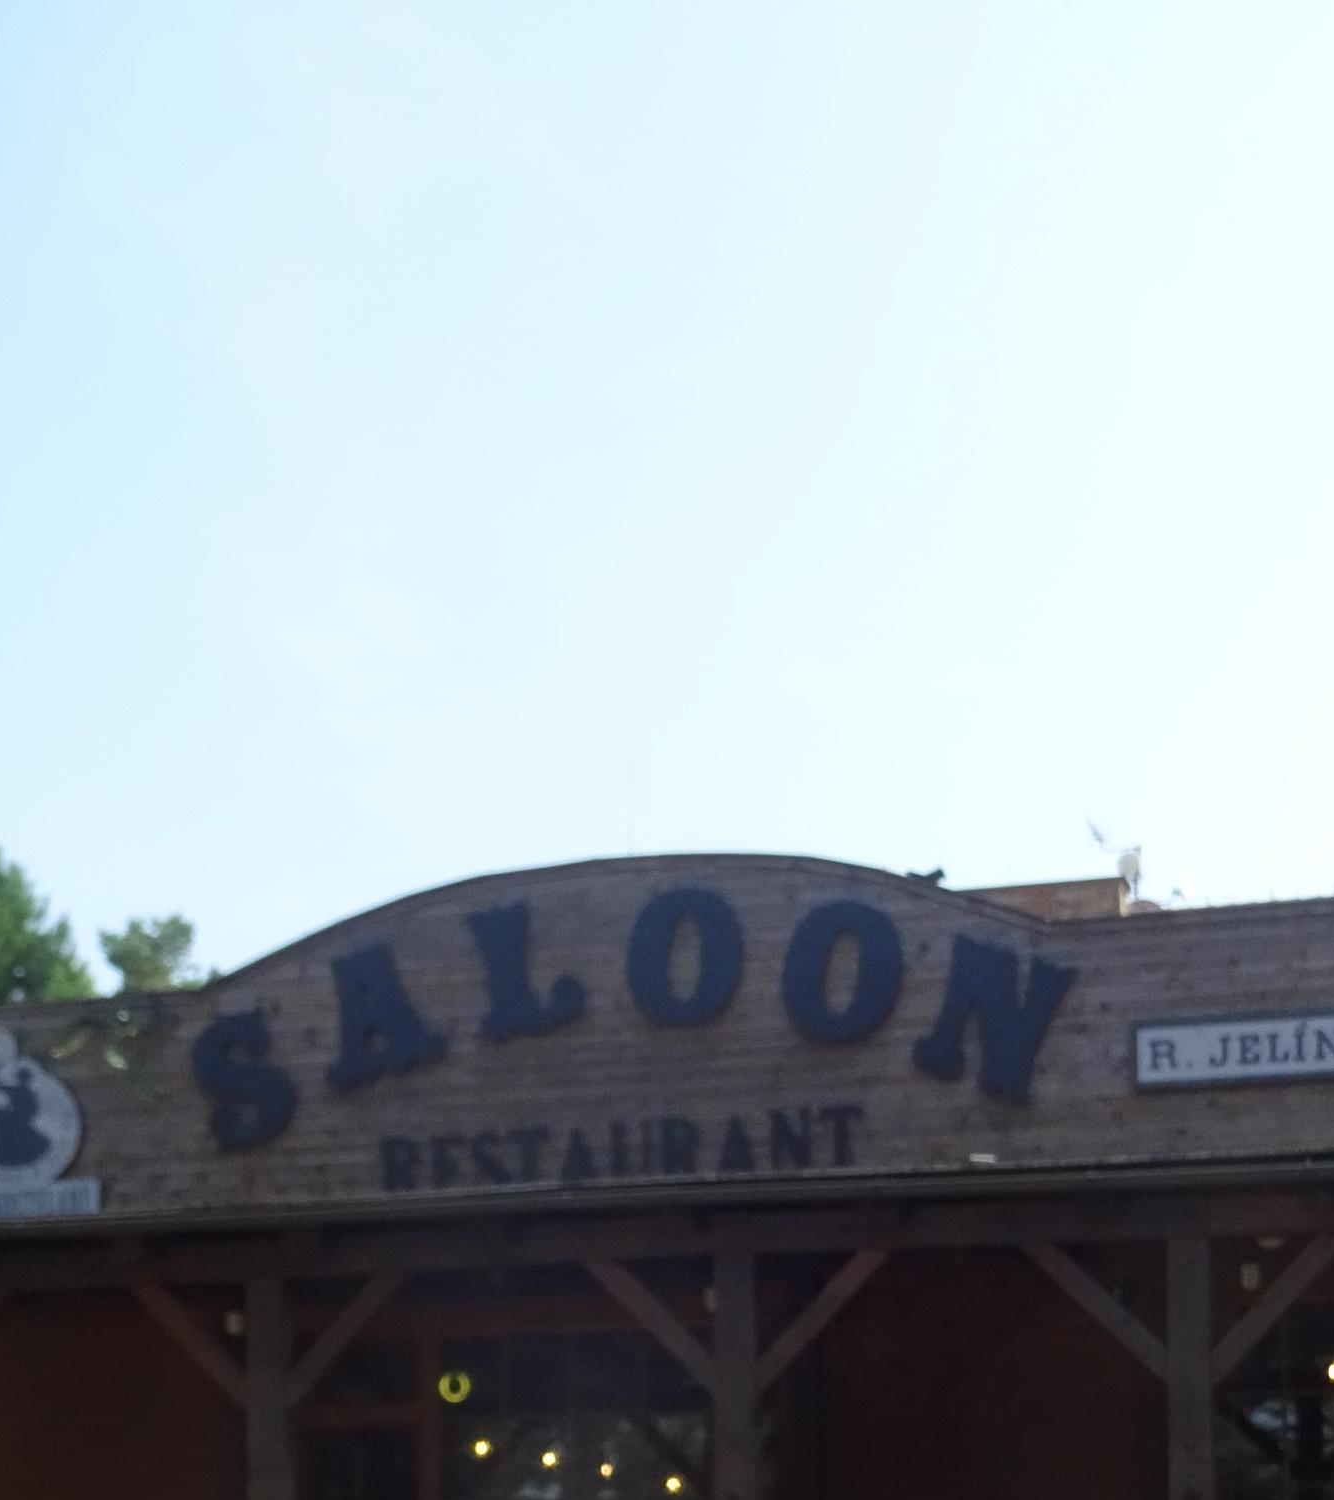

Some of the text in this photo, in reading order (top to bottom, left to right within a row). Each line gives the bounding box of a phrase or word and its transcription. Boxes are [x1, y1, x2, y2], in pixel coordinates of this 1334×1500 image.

[190, 884, 1078, 1152] SALOON
[1147, 1037, 1194, 1072] R.
[379, 1102, 864, 1192] RESTAURANT
